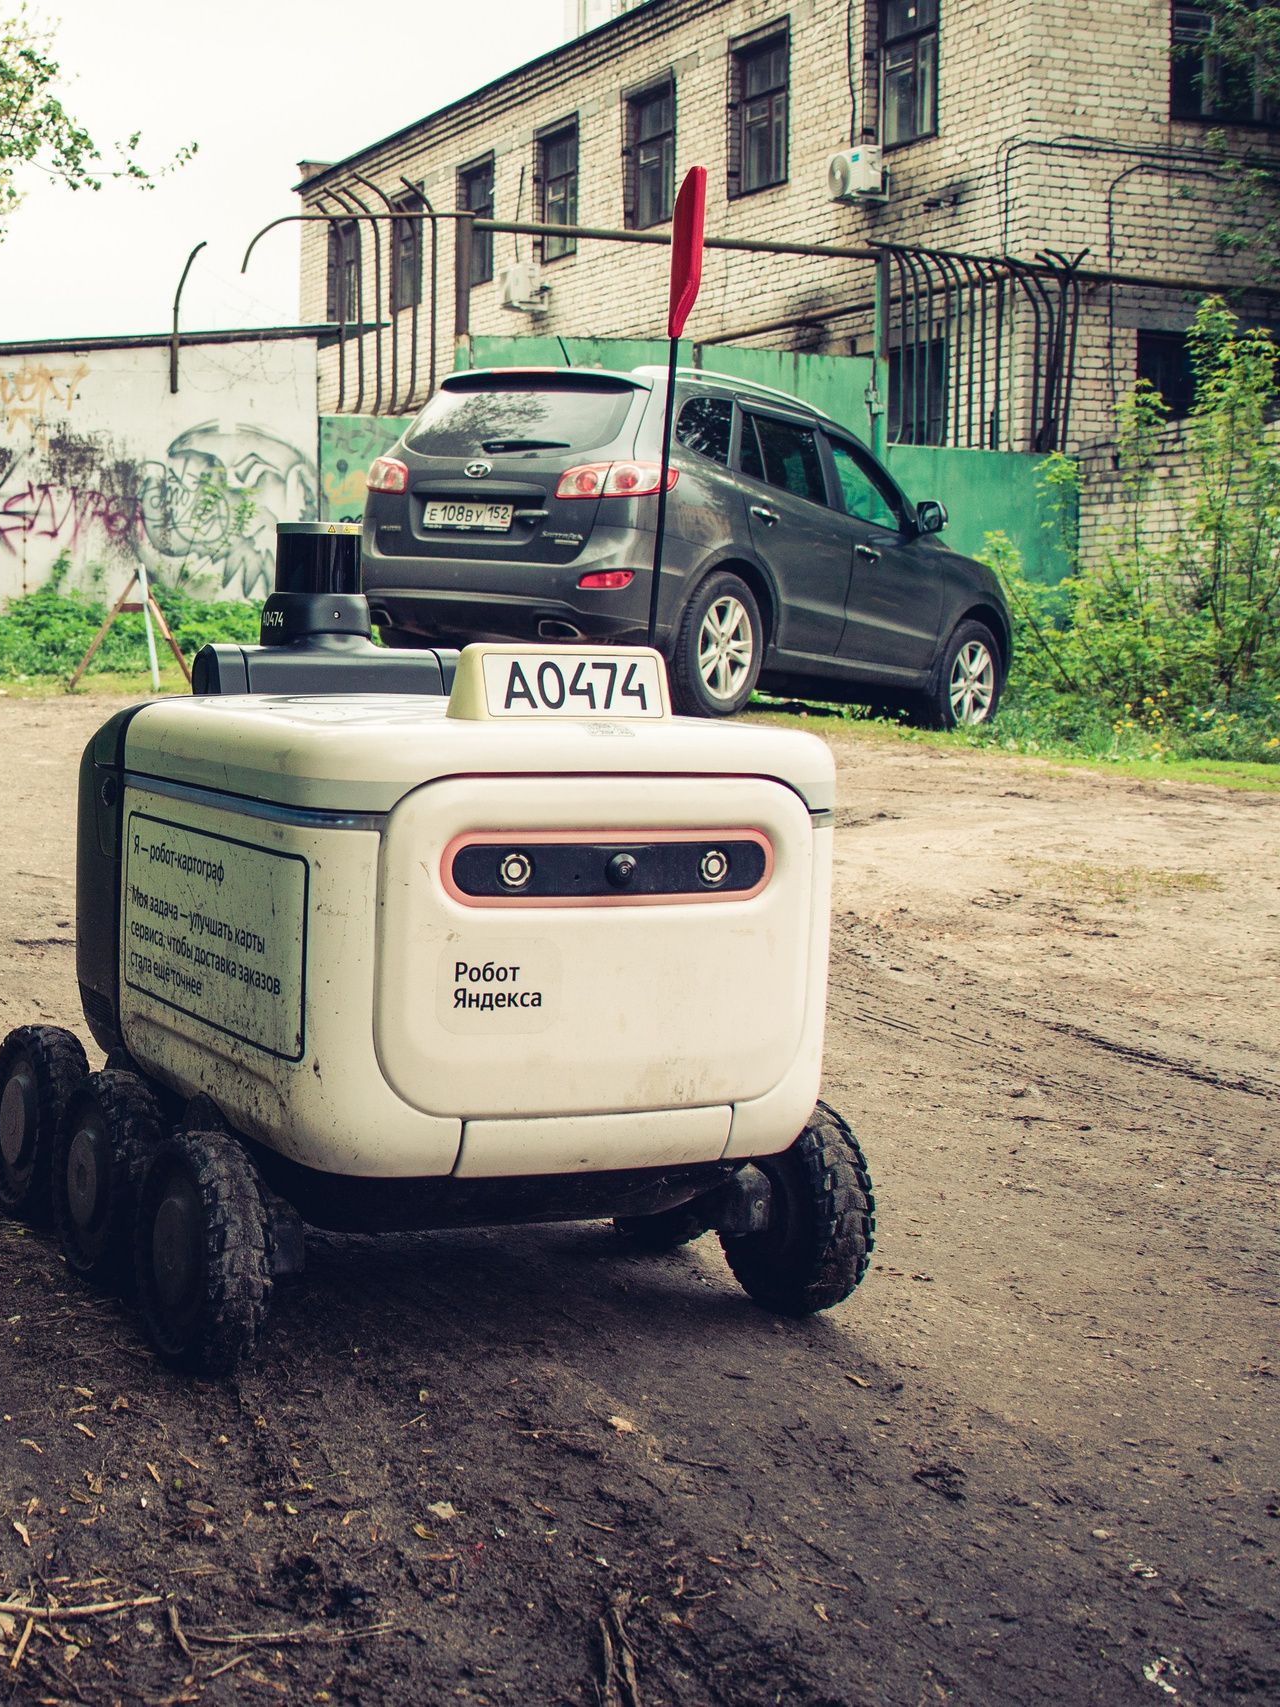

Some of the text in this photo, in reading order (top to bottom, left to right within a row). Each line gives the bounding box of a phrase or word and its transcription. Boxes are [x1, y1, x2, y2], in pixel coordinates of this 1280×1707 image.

[487, 506, 509, 520] 152
[504, 661, 647, 710] A0474
[133, 835, 140, 855] Я
[150, 842, 224, 886] робот-картограф
[131, 885, 148, 909] Моя
[149, 896, 178, 921] задача
[189, 911, 233, 942] улучшать
[235, 928, 266, 954] карты
[130, 921, 281, 995] сервиса, чтобы доставка заказов
[130, 952, 152, 973] стала
[170, 970, 202, 996] точнее
[455, 961, 520, 982] Робот
[453, 988, 542, 1011] Яндекса
